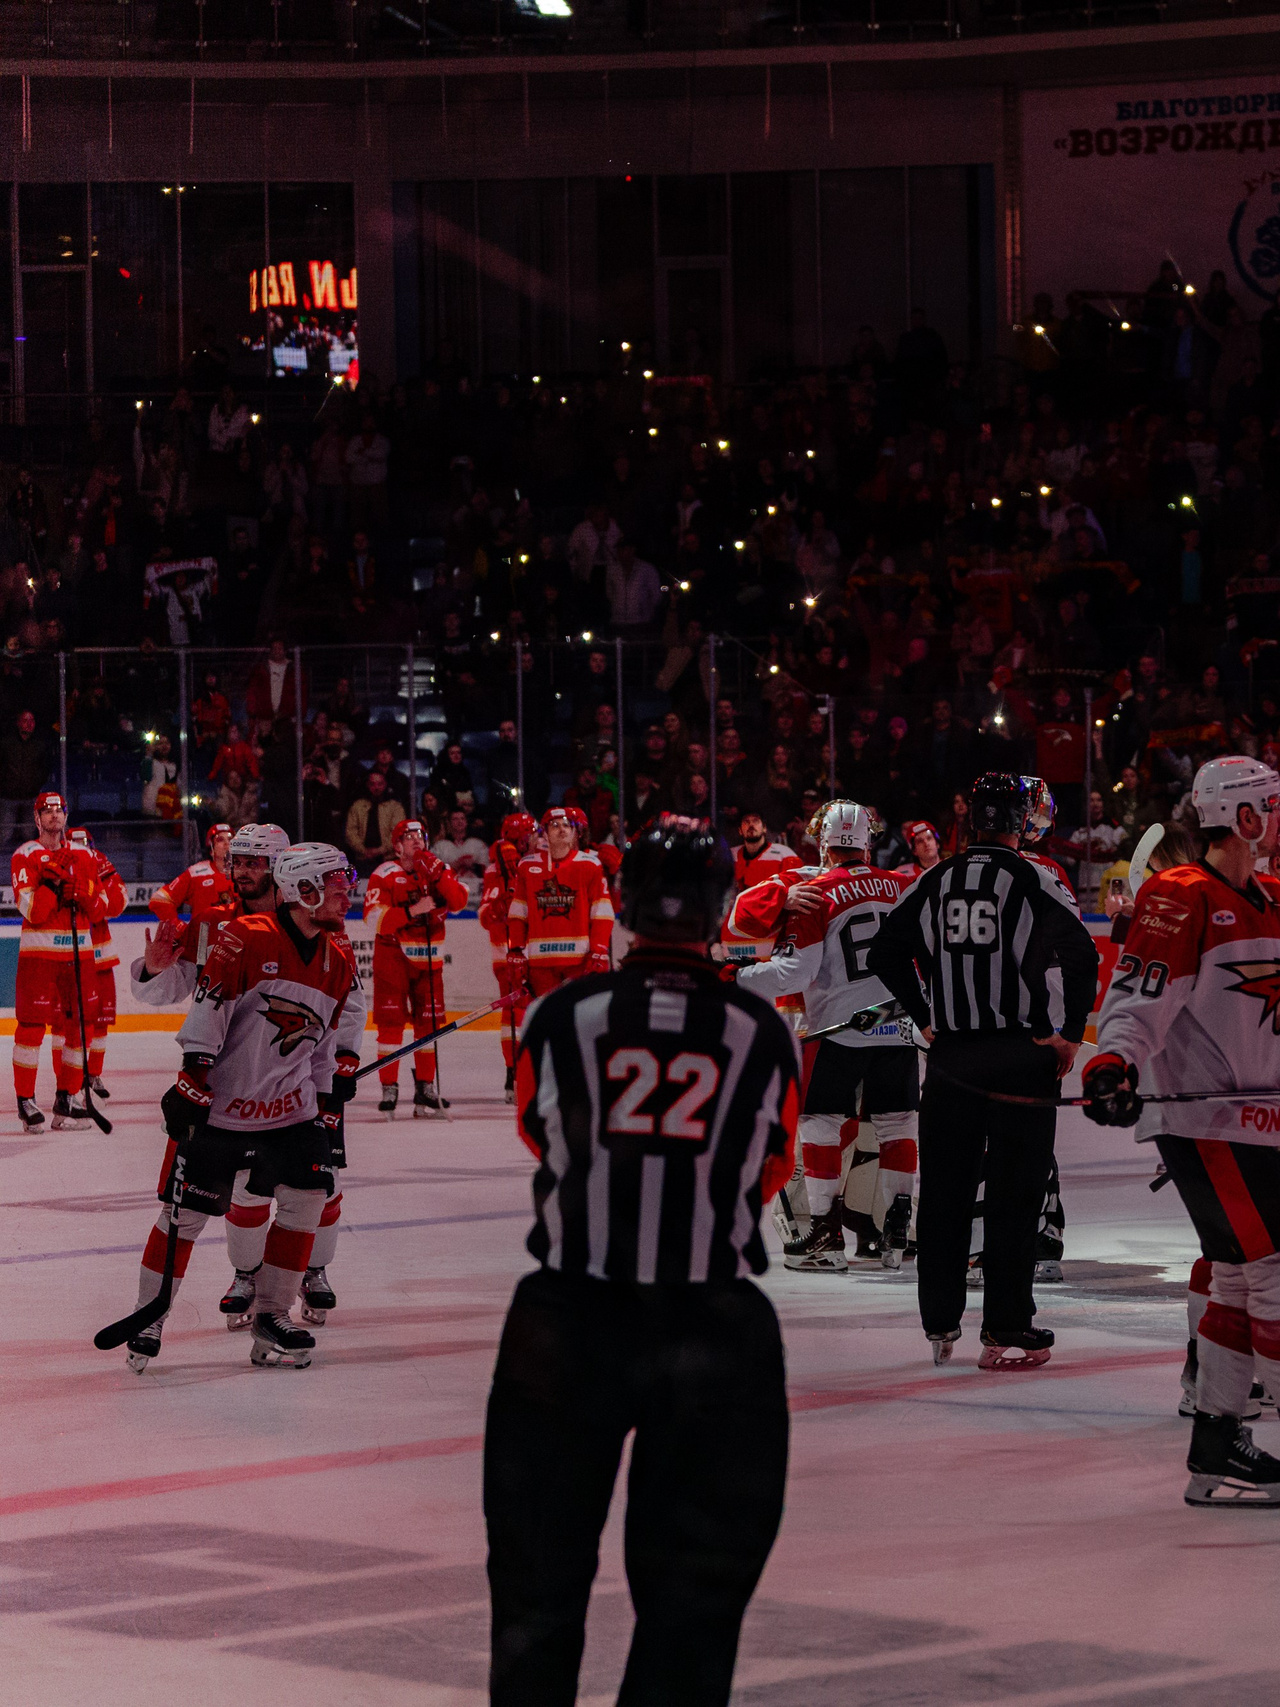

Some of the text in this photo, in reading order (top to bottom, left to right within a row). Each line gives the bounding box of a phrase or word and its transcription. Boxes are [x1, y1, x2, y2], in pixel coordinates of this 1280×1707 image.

[841, 834, 853, 845] 65
[946, 899, 997, 945] 96
[540, 942, 576, 953] SIBUR
[1111, 953, 1169, 998] 20
[177, 1078, 213, 1107] CCM
[225, 1089, 304, 1121] FONBET
[606, 1046, 720, 1141] 22
